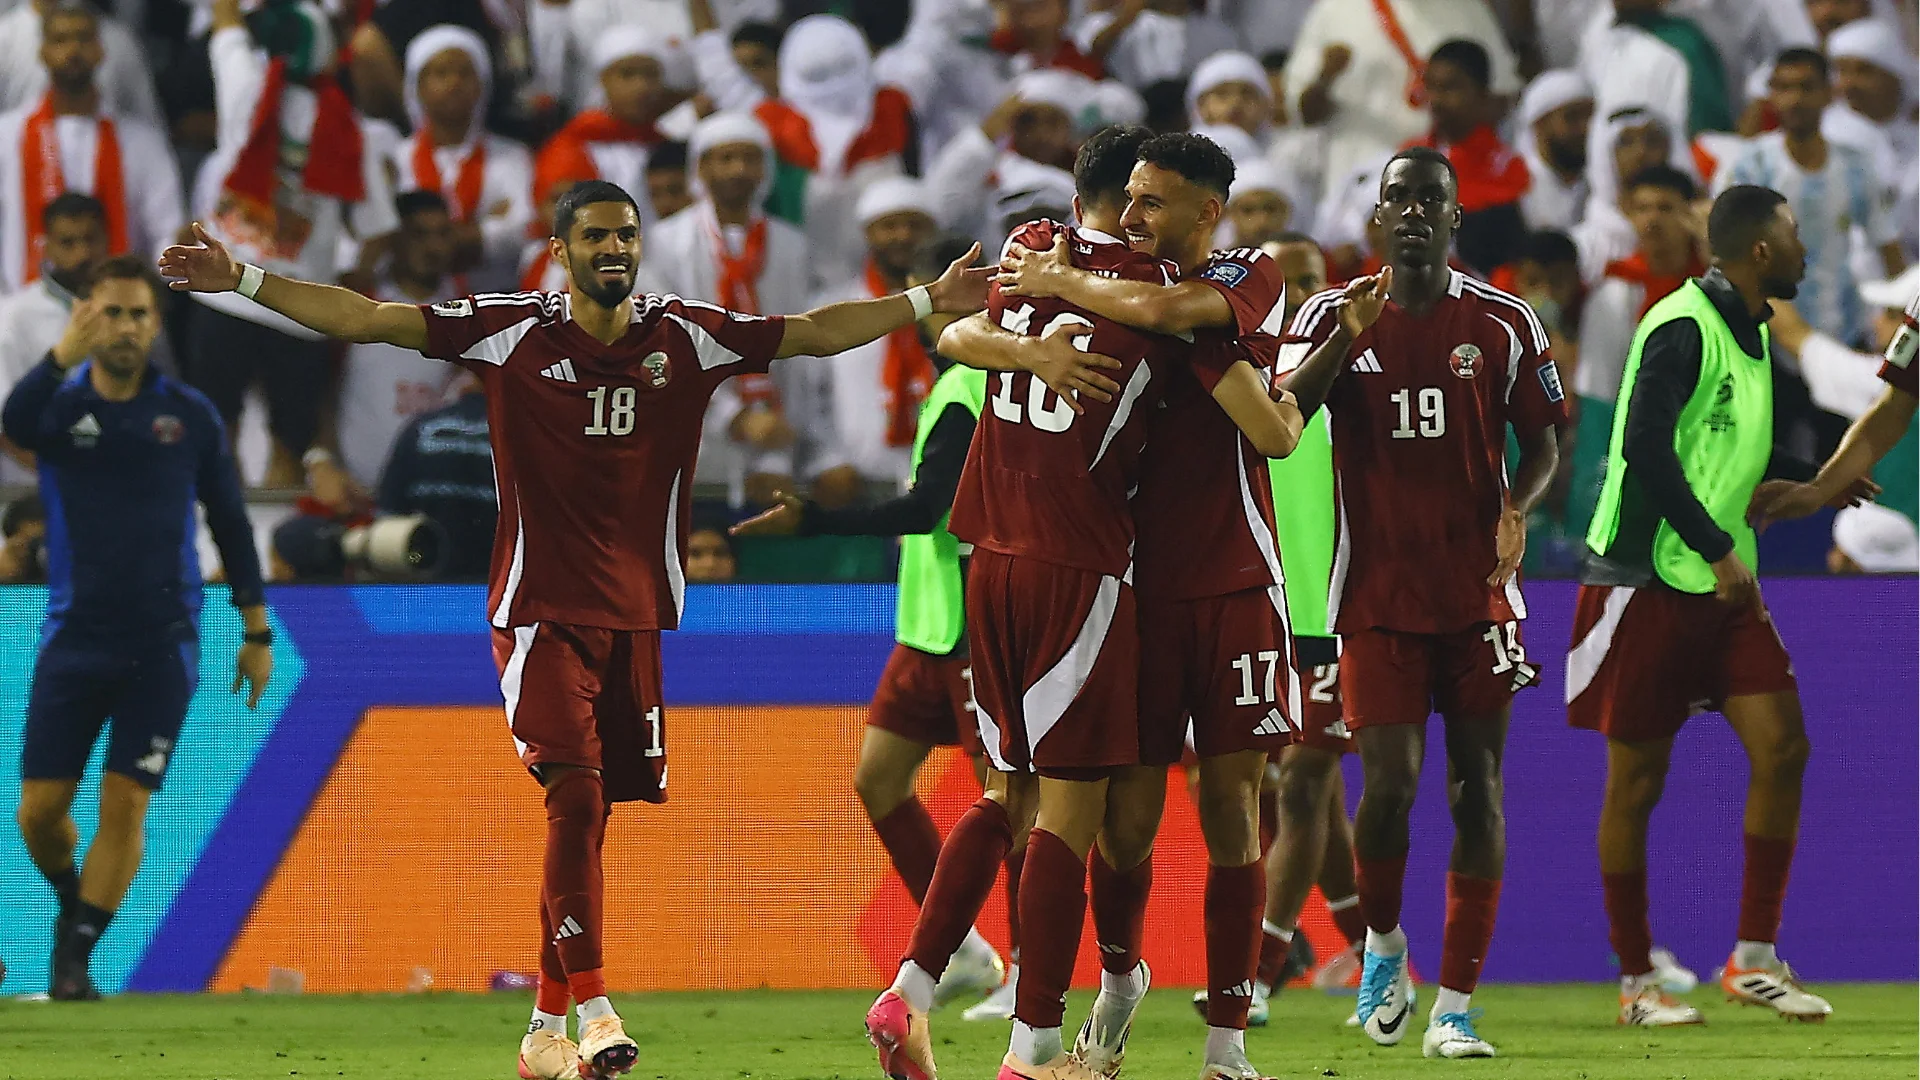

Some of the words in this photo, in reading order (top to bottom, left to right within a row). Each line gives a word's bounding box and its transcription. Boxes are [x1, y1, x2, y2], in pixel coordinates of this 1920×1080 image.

[584, 386, 636, 436] 18
[1391, 387, 1446, 439] 19
[1232, 650, 1279, 706] 17
[1309, 662, 1343, 703] 2
